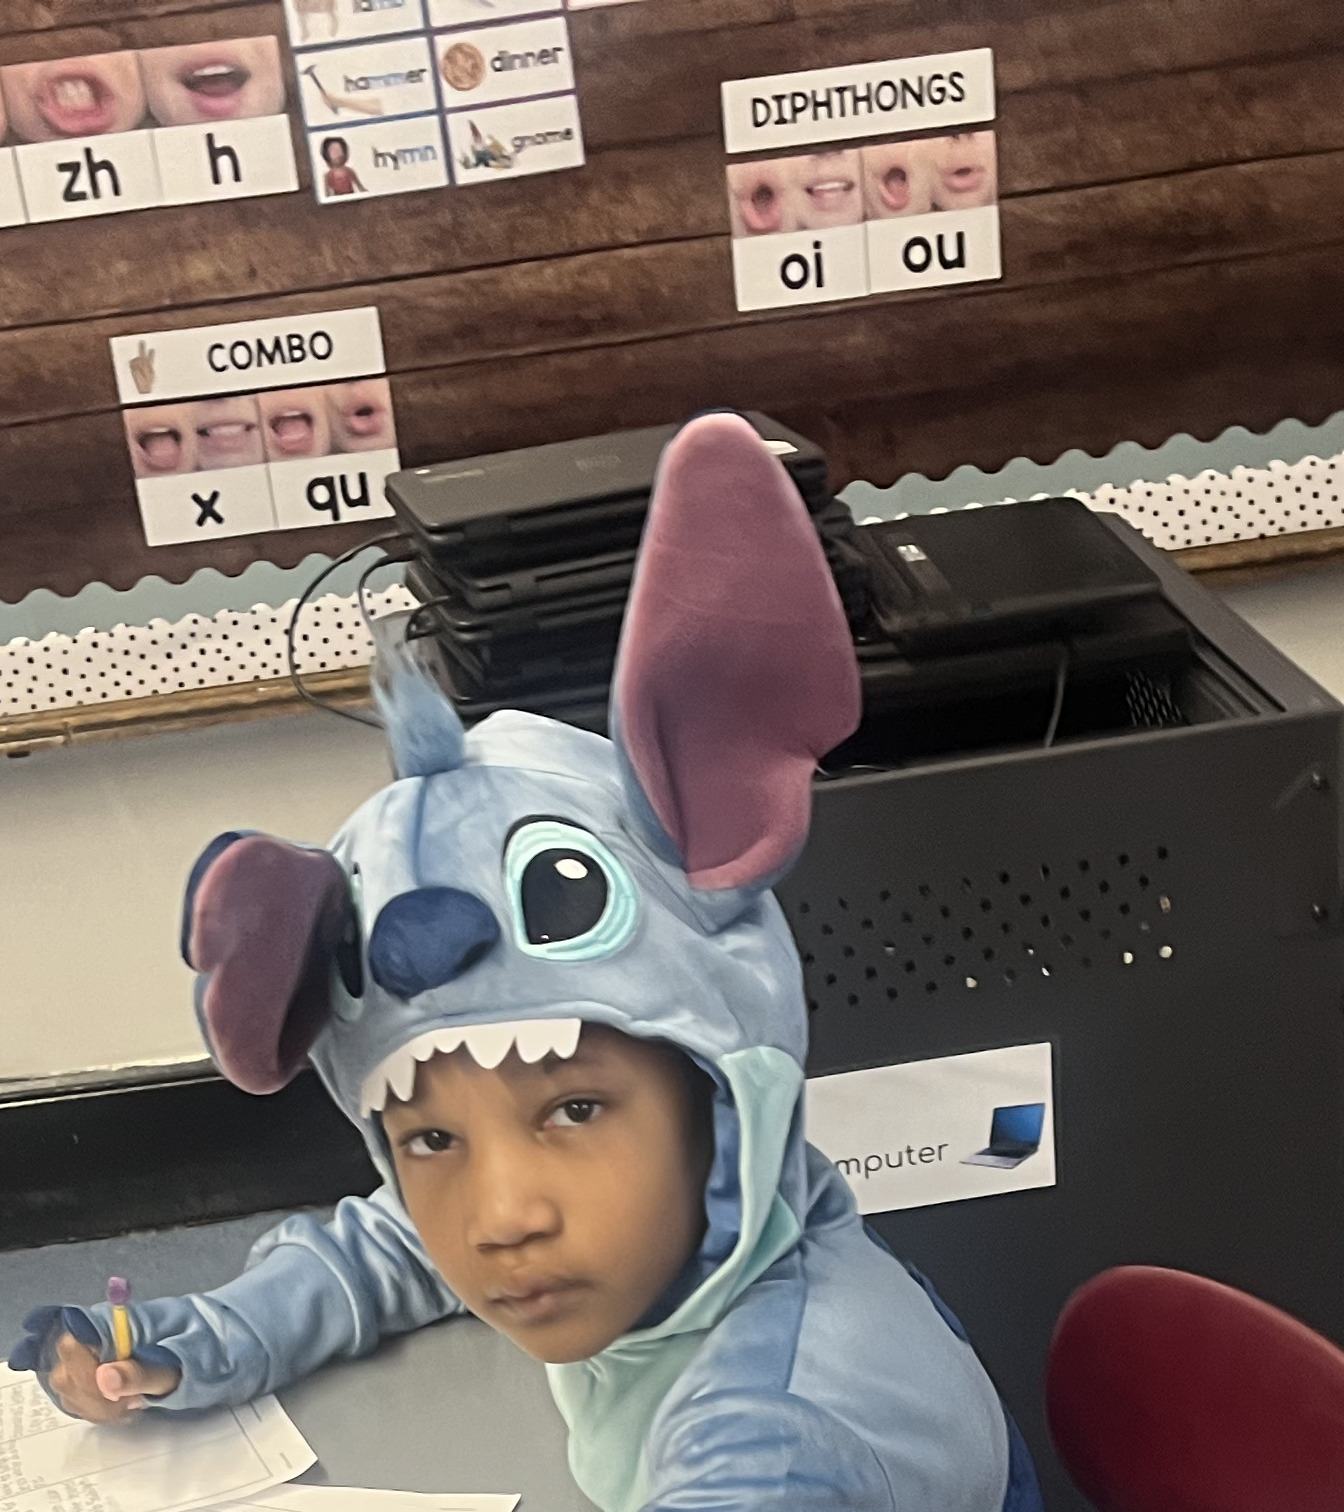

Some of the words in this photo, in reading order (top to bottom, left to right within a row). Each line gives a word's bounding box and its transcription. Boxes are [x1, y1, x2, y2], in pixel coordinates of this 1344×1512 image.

[490, 46, 564, 73] dinner
[749, 71, 968, 129] DIPHTHONGS
[55, 146, 124, 203] zh
[205, 132, 242, 187] h
[371, 143, 438, 171] hymn
[779, 240, 828, 290] oi
[901, 226, 968, 274] ou
[205, 330, 336, 373] COMBO
[188, 487, 227, 529] x
[304, 466, 371, 522] qu
[835, 1143, 950, 1180] mputer
